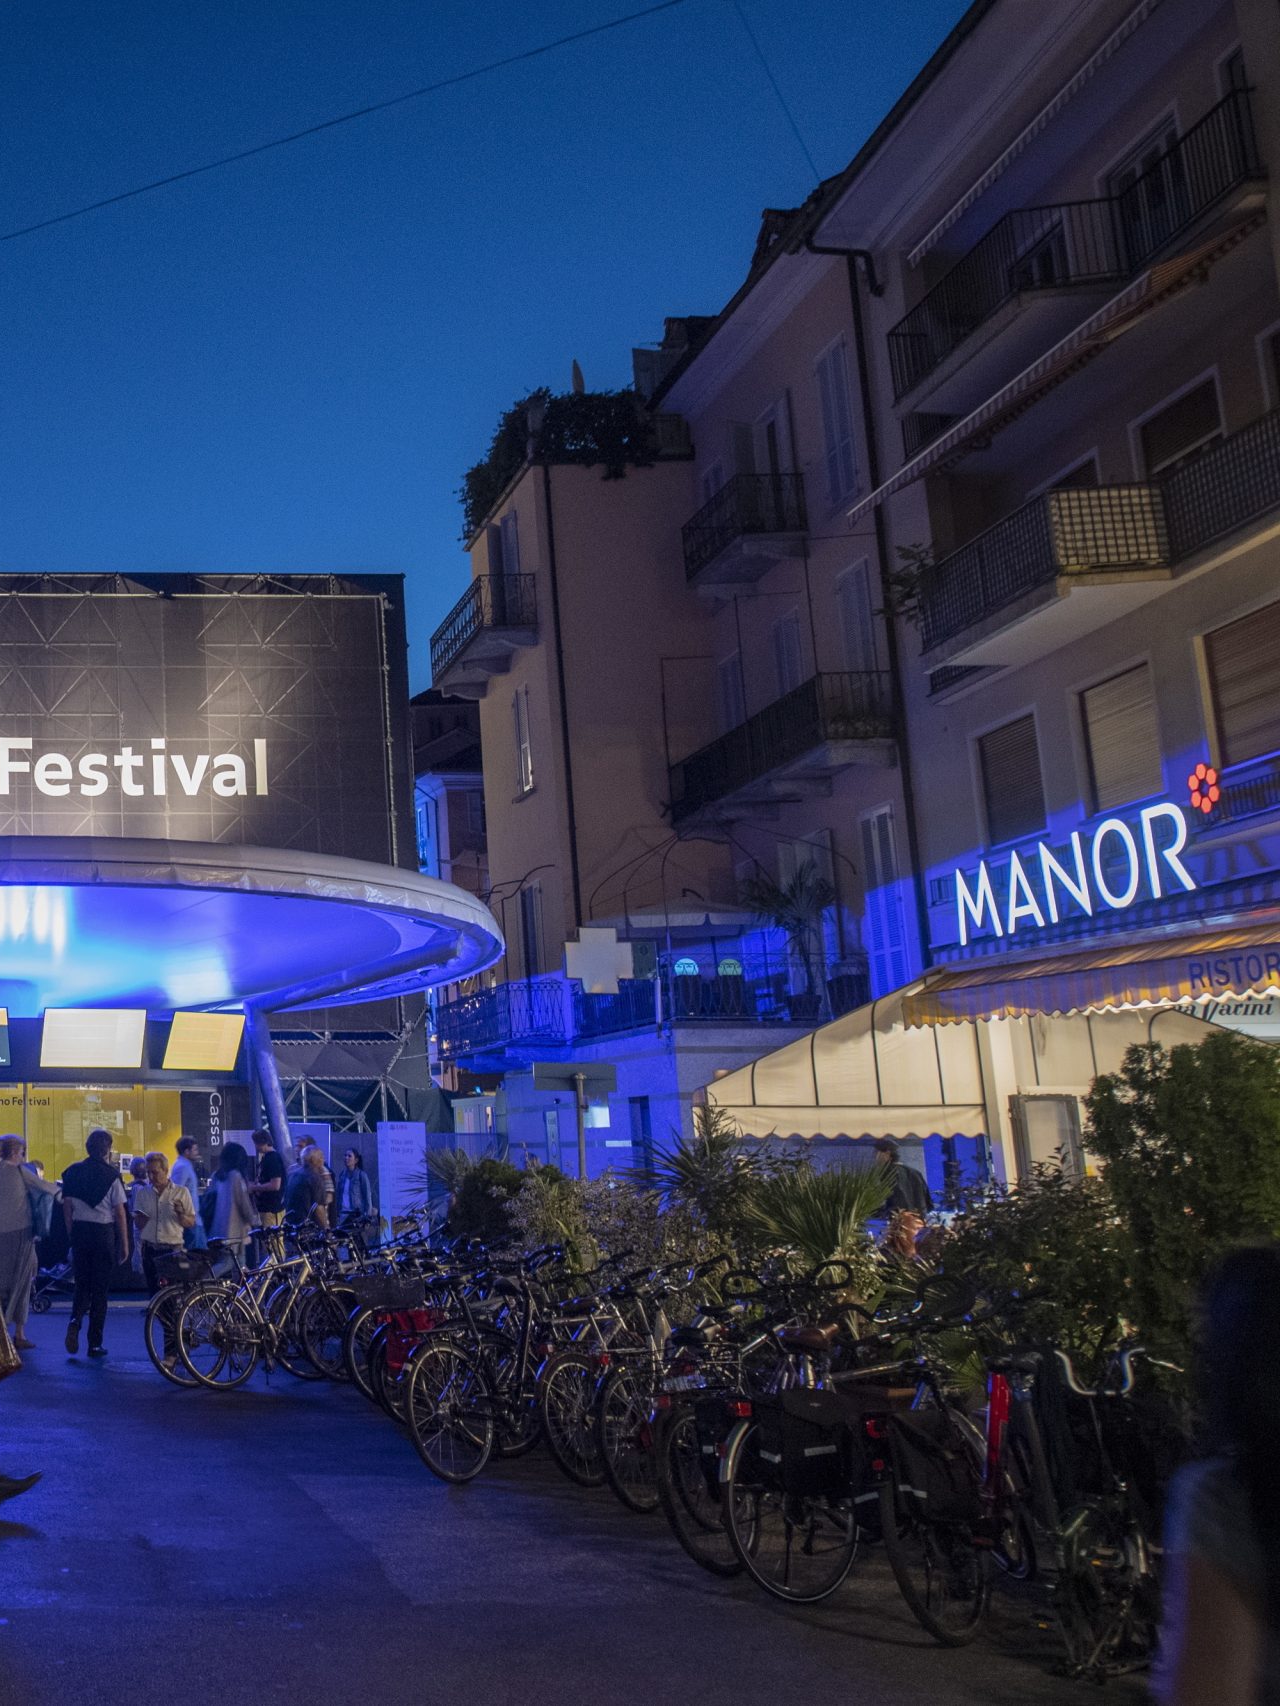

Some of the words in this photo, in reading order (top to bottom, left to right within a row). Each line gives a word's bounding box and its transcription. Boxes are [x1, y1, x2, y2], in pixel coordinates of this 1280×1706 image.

[955, 802, 1197, 946] MANOR
[12, 1097, 50, 1106] Fetival
[209, 1092, 222, 1146] Cassa
